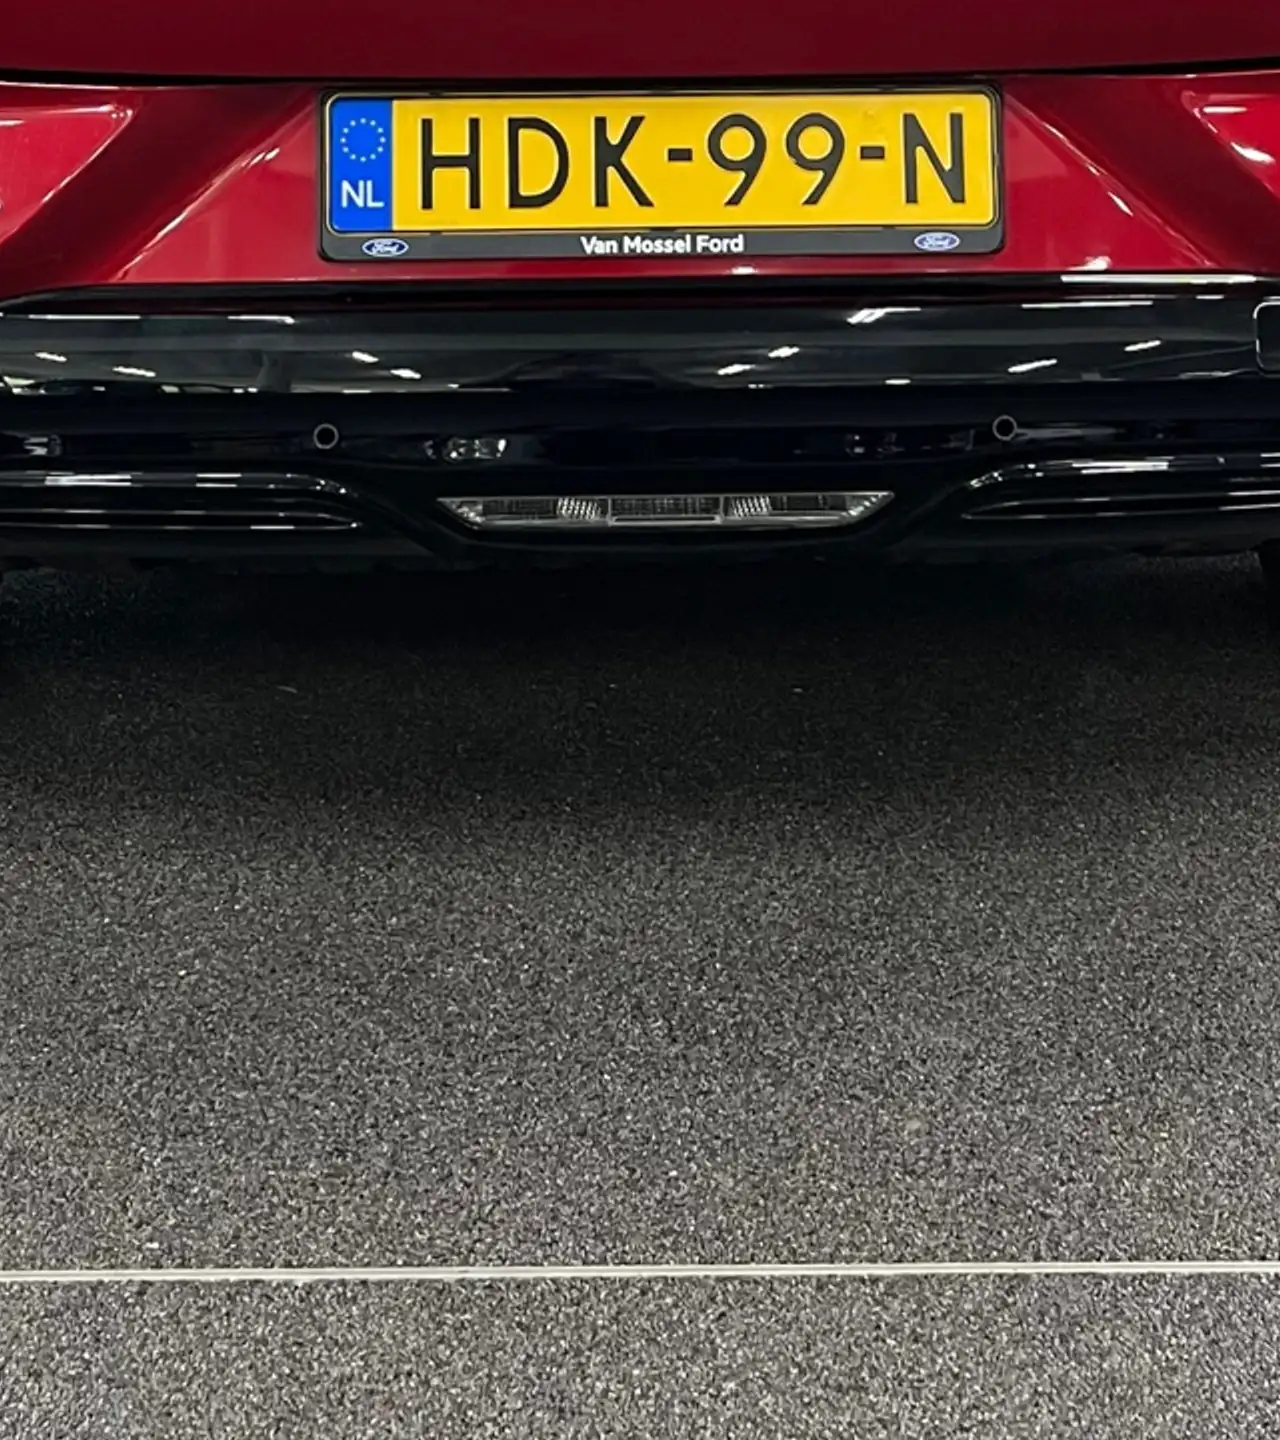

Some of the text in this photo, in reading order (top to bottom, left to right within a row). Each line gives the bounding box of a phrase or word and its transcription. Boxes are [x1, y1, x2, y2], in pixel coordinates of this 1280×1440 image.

[420, 113, 966, 210] HDK-99-N
[341, 180, 384, 208] NL
[580, 234, 744, 254] Van Mossel Ford
